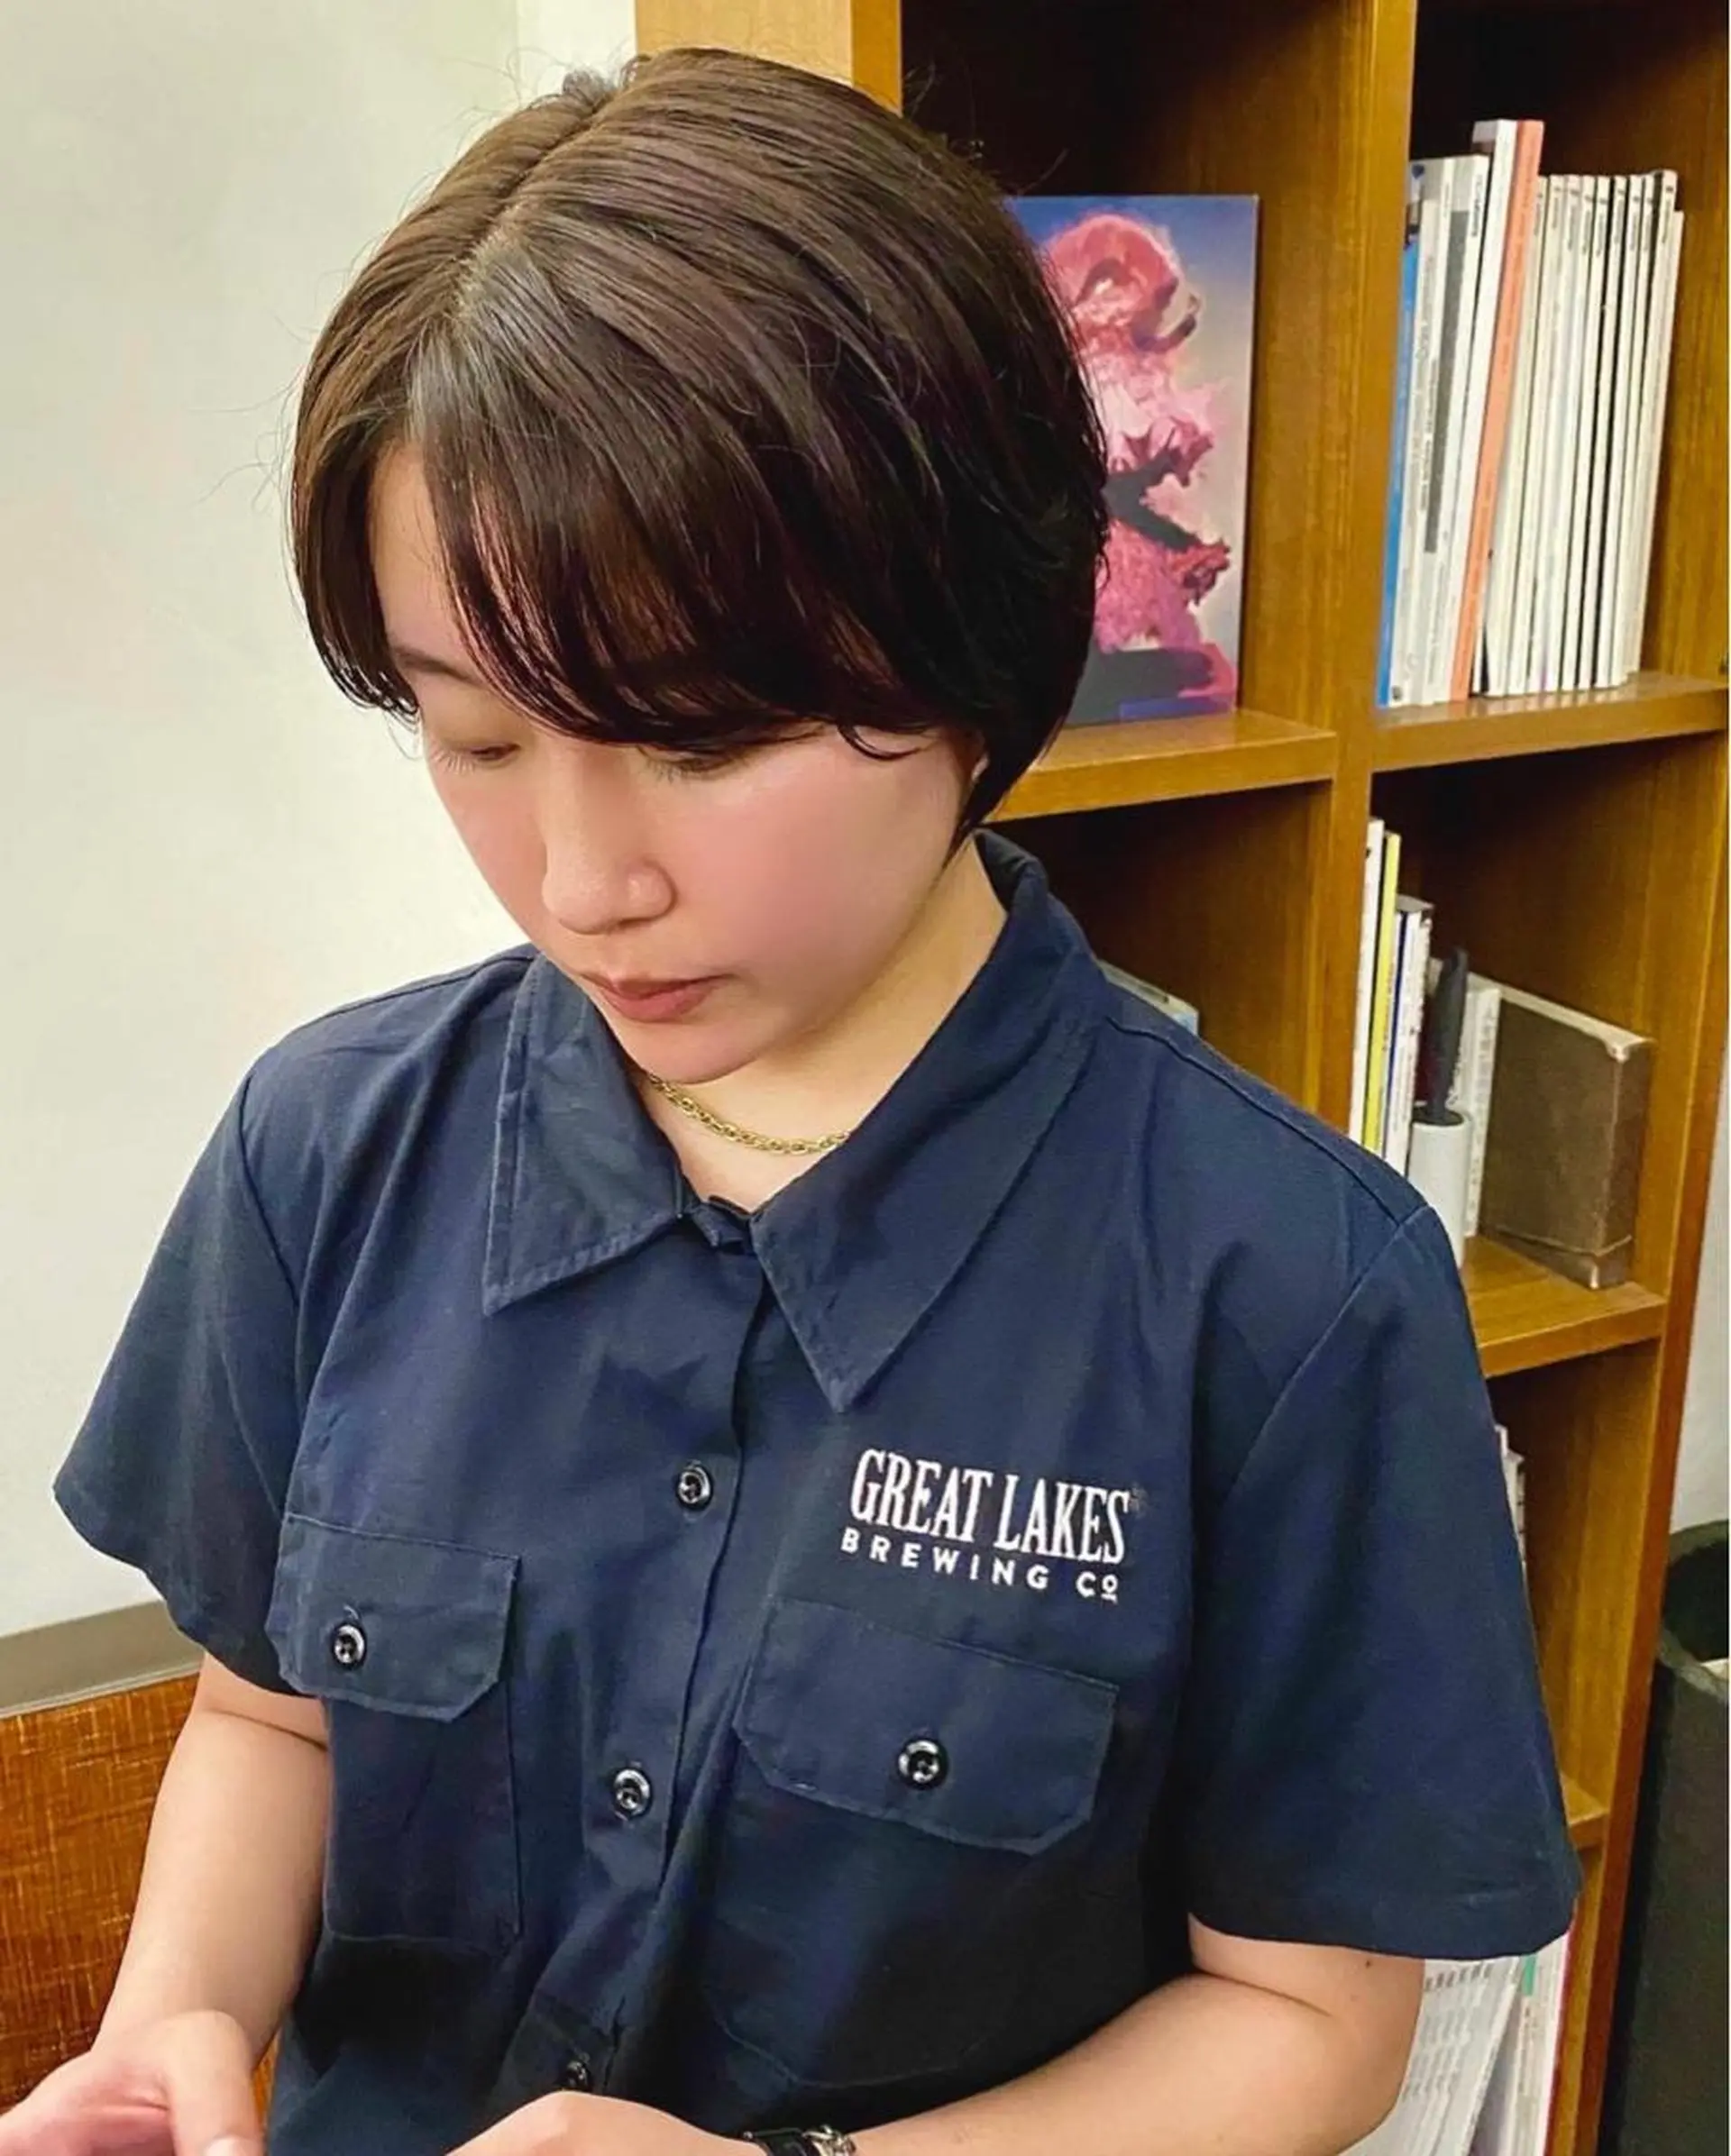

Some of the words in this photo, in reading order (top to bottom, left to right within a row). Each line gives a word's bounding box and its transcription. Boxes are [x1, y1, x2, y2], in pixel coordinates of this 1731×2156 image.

[850, 1448, 994, 1543] GREAT
[994, 1474, 1131, 1565] LAKES
[840, 1526, 1049, 1590] BREWING
